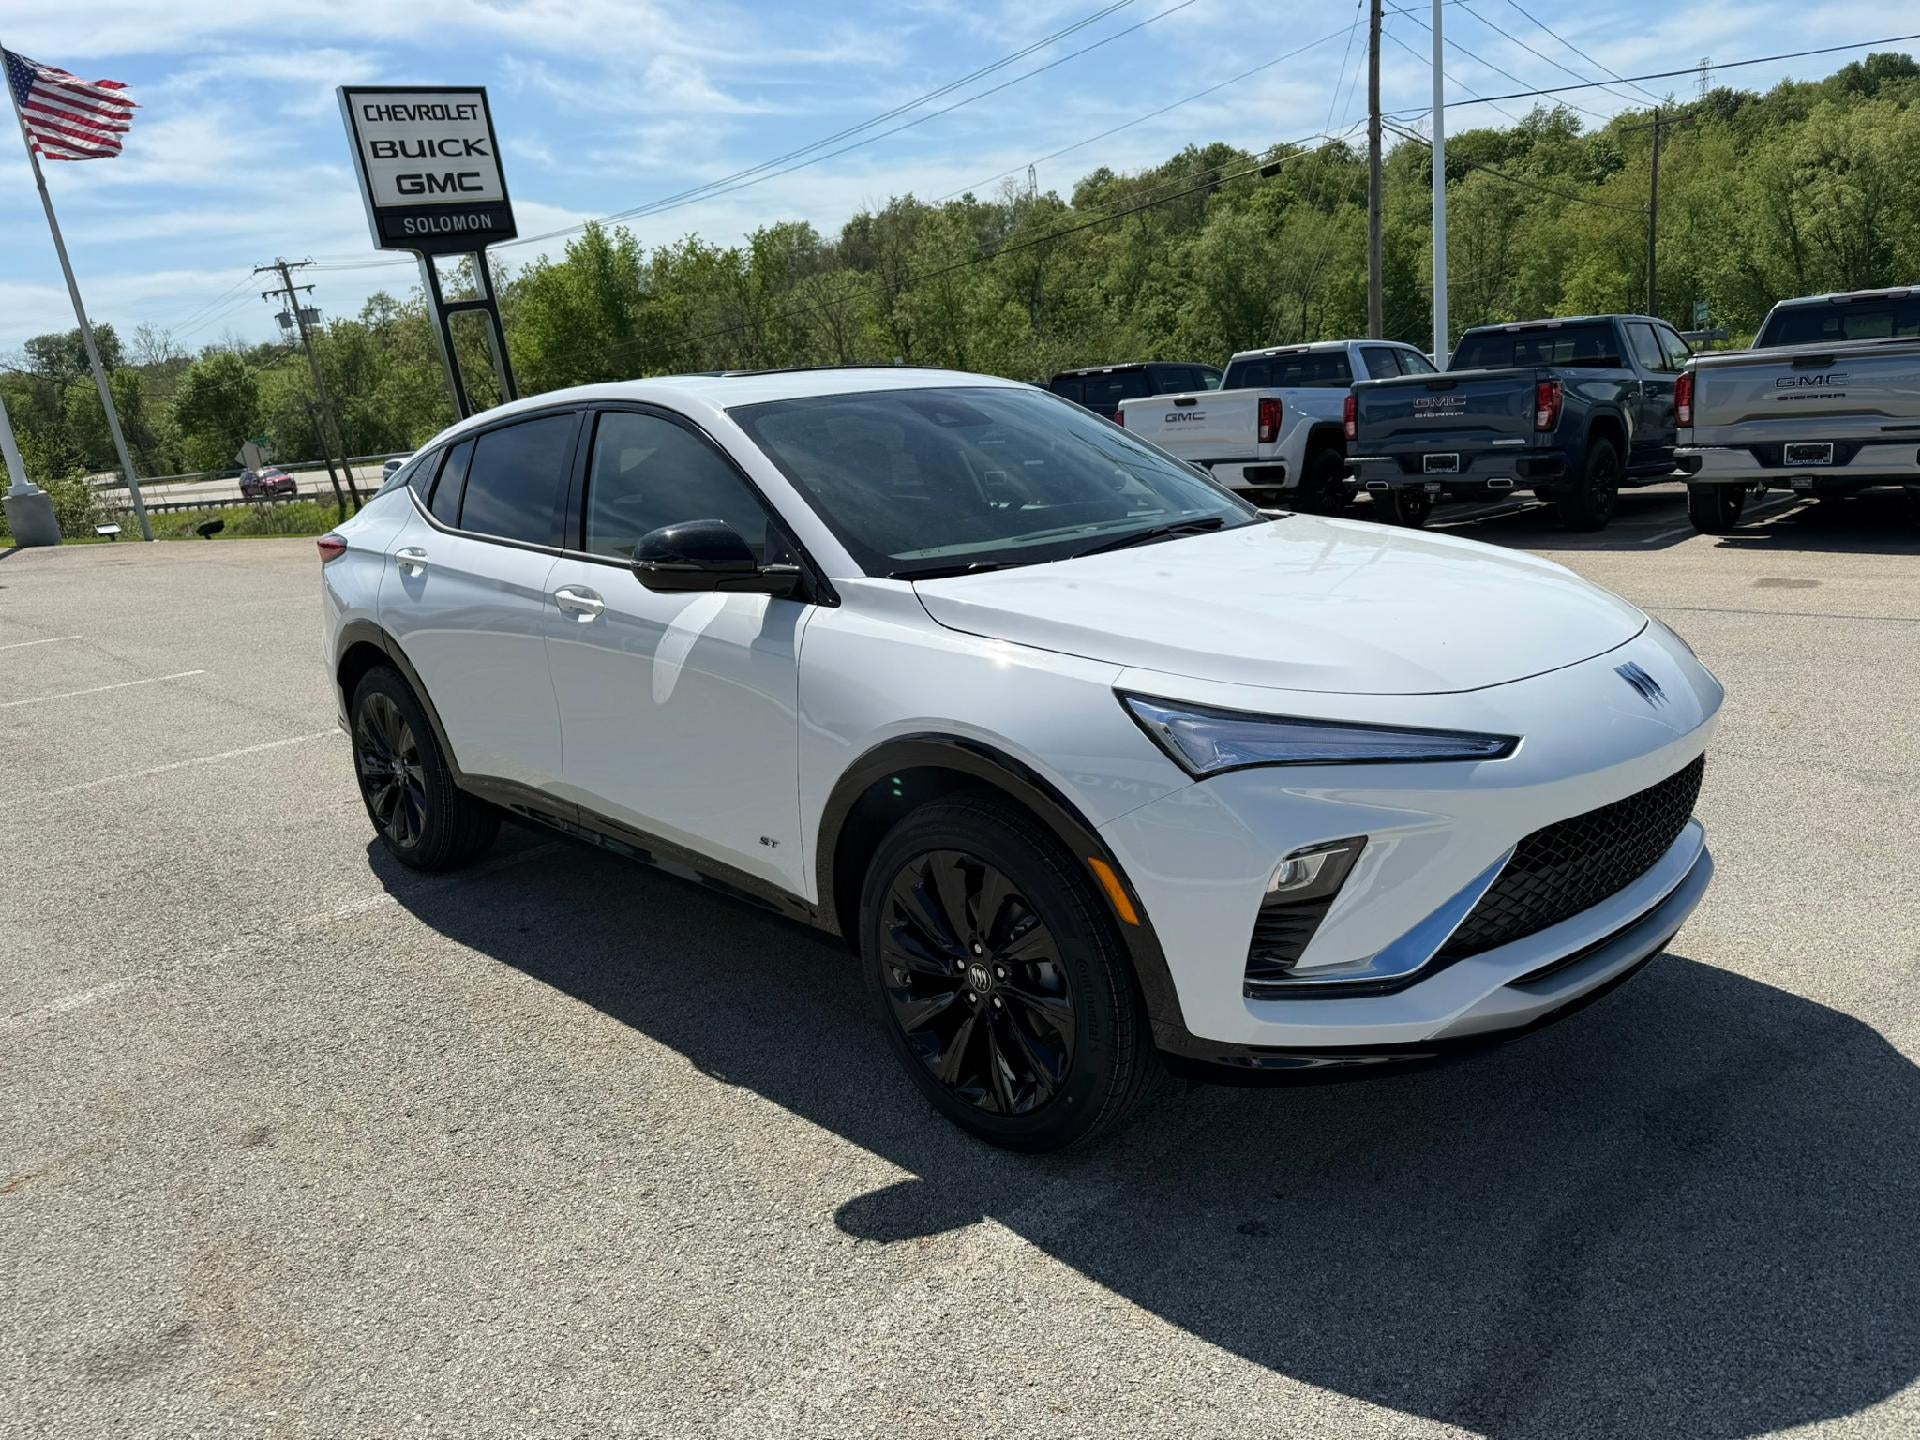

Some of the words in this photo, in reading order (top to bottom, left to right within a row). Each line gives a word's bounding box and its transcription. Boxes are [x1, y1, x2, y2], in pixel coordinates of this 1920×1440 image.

[363, 104, 478, 121] CHEVROLET
[369, 138, 490, 159] BUICK
[395, 172, 484, 195] GMC
[403, 214, 493, 234] SOLOMON
[1775, 373, 1849, 389] GMC
[1413, 394, 1467, 409] GMC
[1776, 392, 1847, 401] SIERRA
[1165, 411, 1208, 423] GMC
[759, 836, 780, 848] ST
